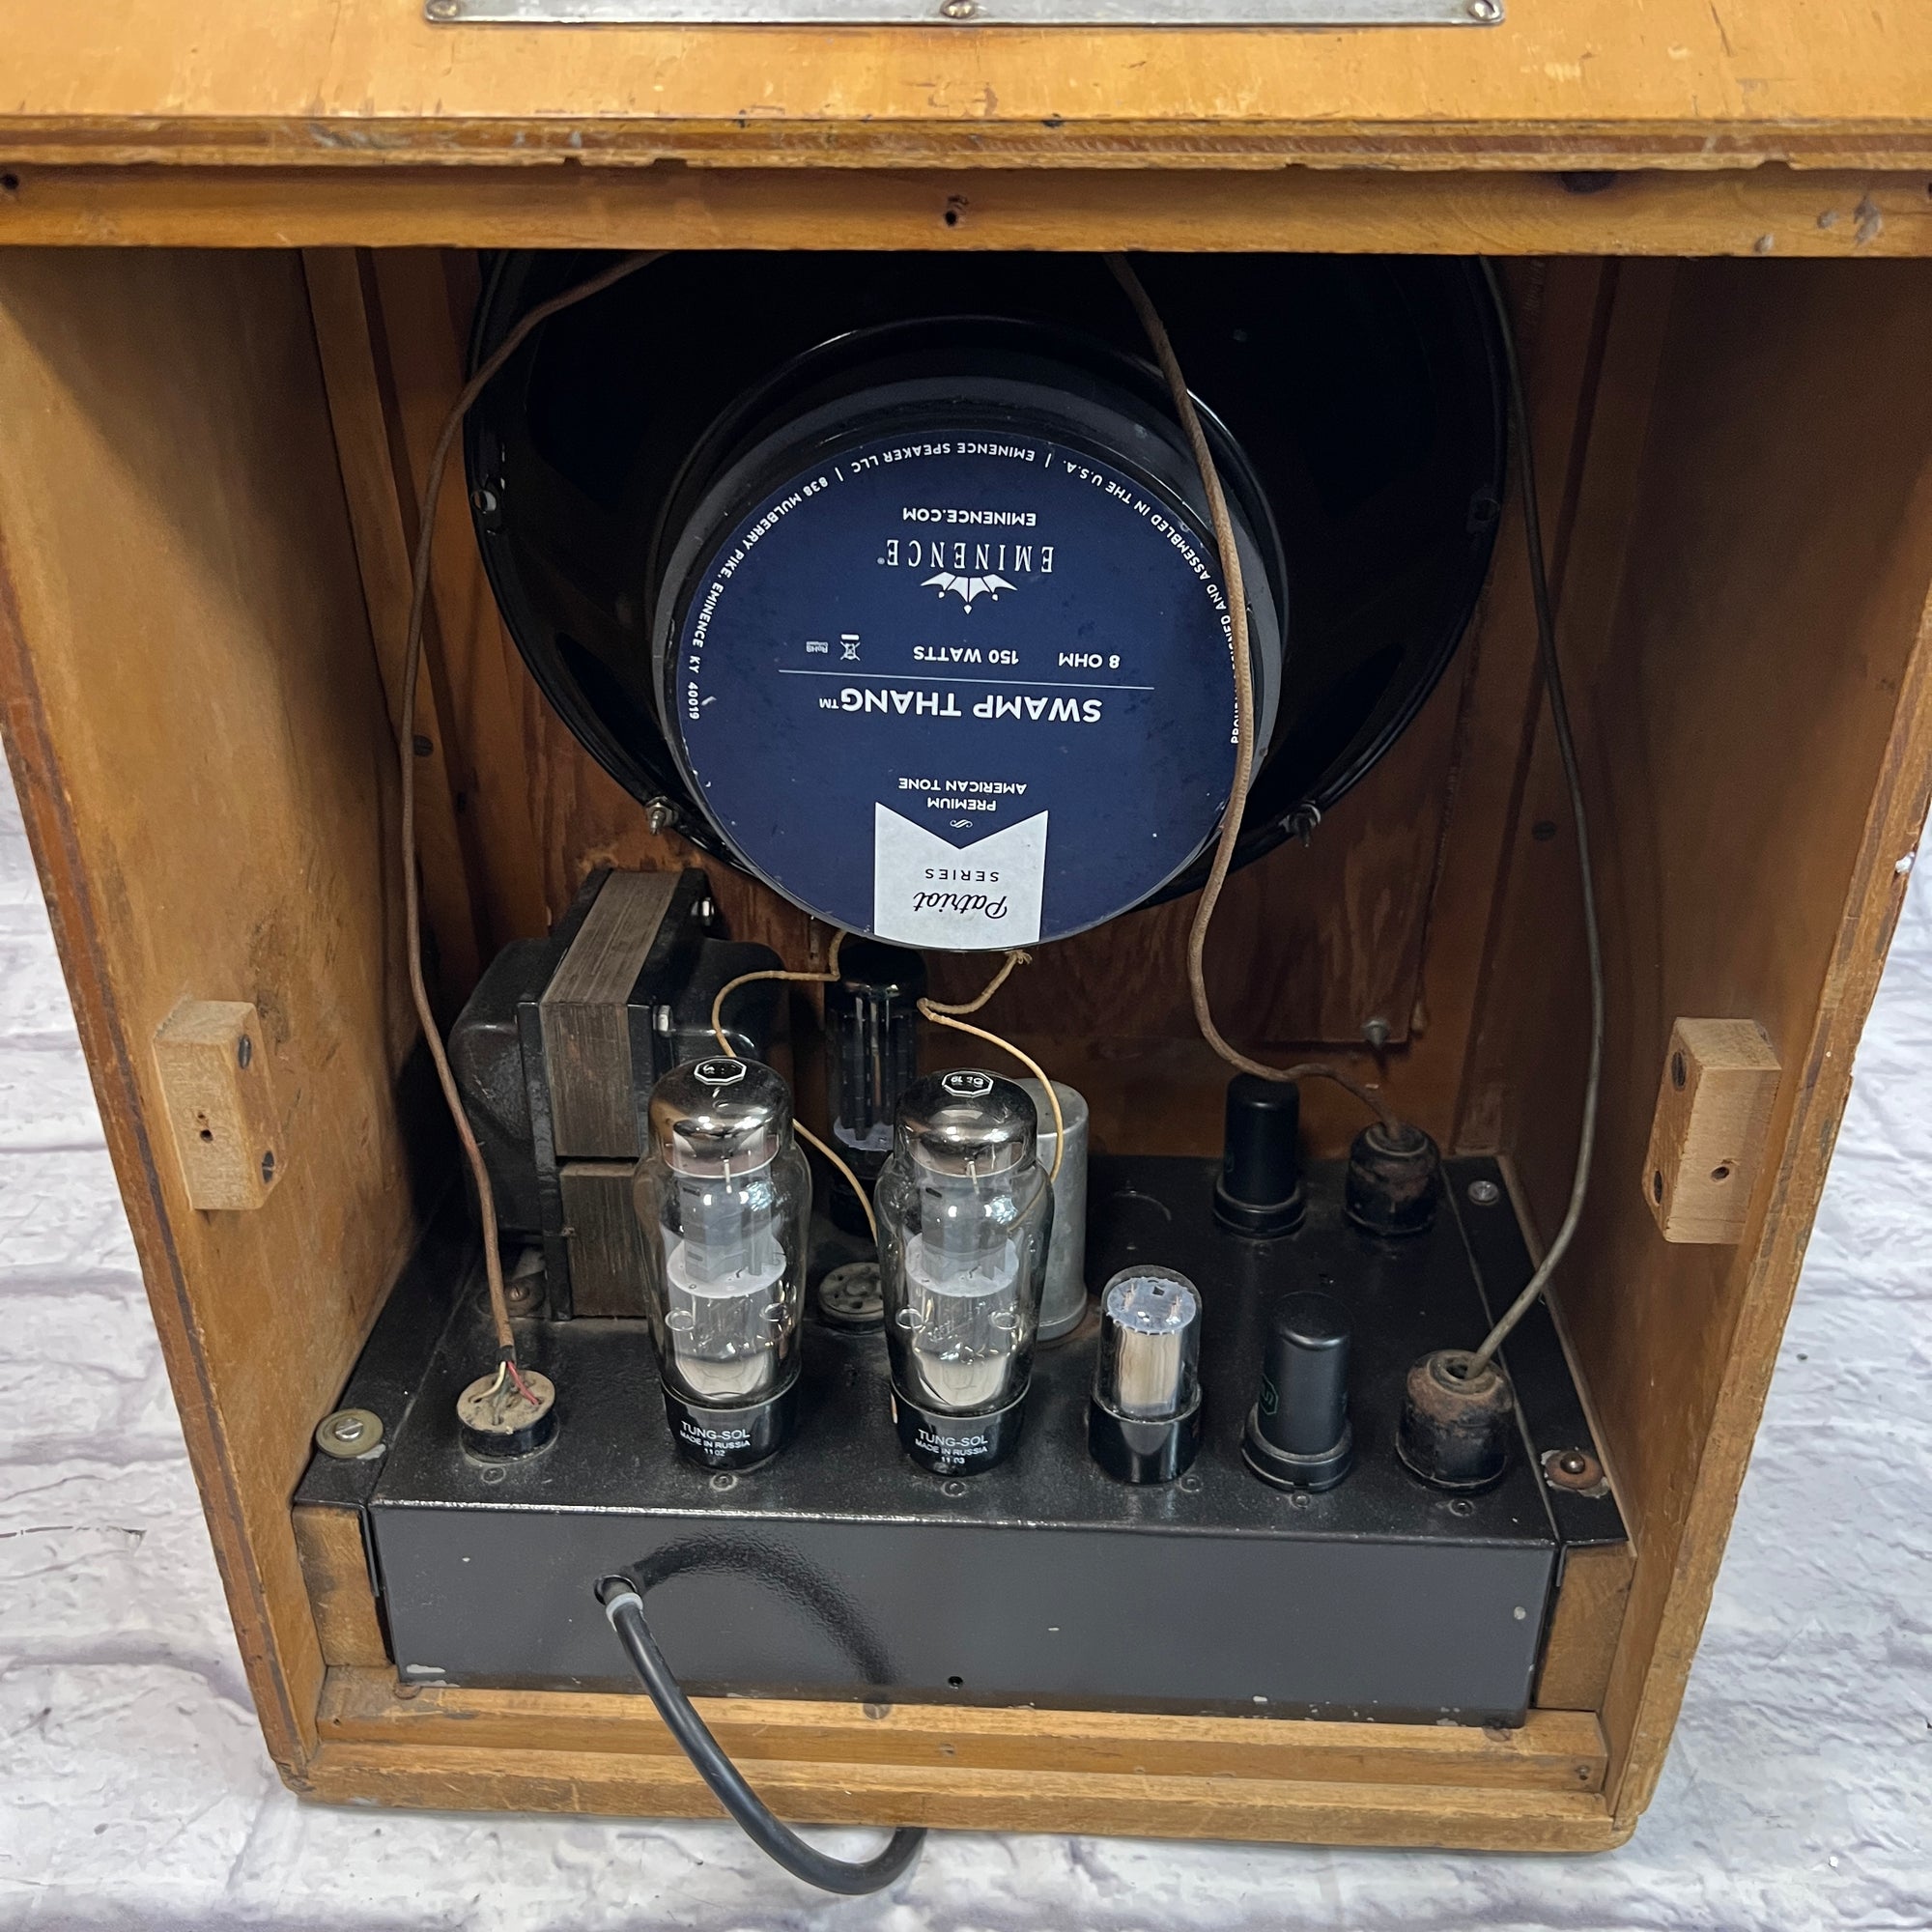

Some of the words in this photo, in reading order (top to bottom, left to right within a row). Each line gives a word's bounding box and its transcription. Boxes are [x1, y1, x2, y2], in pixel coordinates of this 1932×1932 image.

[883, 442, 951, 463] SPEAKER
[956, 442, 1036, 462] EMINENCE
[851, 454, 879, 474] LLC
[1063, 460, 1103, 487] U.S.A.
[803, 476, 829, 497] 838
[1105, 481, 1133, 504] THE
[902, 507, 1037, 526] EMINENCE.COM
[1133, 499, 1151, 517] IN
[742, 493, 803, 551] MULBERRY
[1151, 514, 1210, 581] ASSEMBLED
[1207, 583, 1227, 611] AND
[692, 582, 724, 648] EMINENCE
[689, 655, 701, 673] KY
[913, 645, 982, 663] WATTS
[988, 649, 1020, 665] 150
[1058, 652, 1103, 668] OHM
[1109, 653, 1121, 669] 8
[688, 681, 700, 721] 40019
[973, 695, 1103, 723] SWAMP
[897, 777, 942, 791] TONE
[946, 780, 1028, 796] AMERICAN
[927, 797, 997, 811] PREMIUM
[924, 867, 1000, 883] SERIES
[913, 892, 1008, 919] Patriot
[679, 1430, 702, 1446] MADE
[715, 1440, 752, 1450] RUSSIA
[681, 1420, 752, 1440] TUNG-SOL
[918, 1428, 989, 1447] TUNG-SOL
[915, 1438, 940, 1454] MADE
[952, 1445, 988, 1457] RUSSIA
